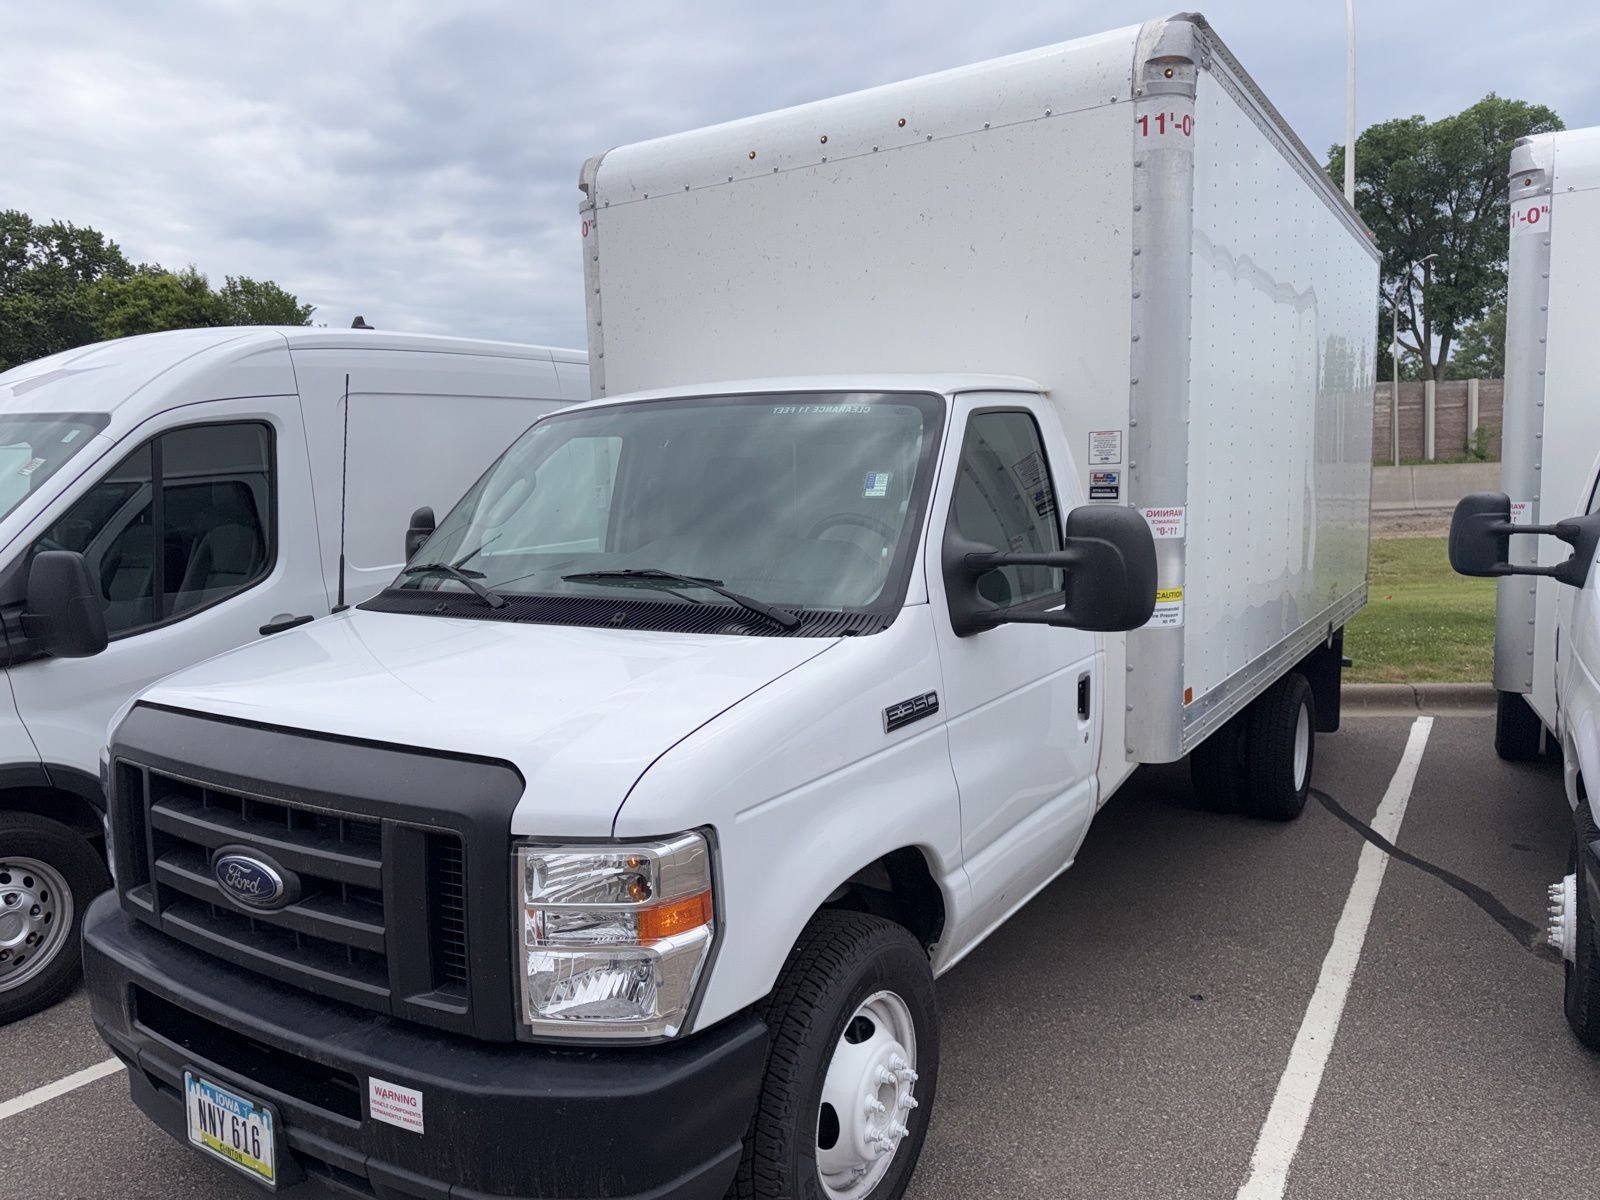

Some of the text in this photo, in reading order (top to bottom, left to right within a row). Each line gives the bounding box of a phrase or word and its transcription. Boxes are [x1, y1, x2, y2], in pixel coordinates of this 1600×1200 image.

[1137, 112, 1194, 137] 11'-0
[226, 863, 261, 894] Ford
[215, 1092, 240, 1115] IOWA
[374, 1085, 417, 1107] WARNING
[389, 1104, 421, 1119] COMPONENTS
[198, 1098, 261, 1160] NNY 616
[219, 1142, 243, 1162] CLINTON
